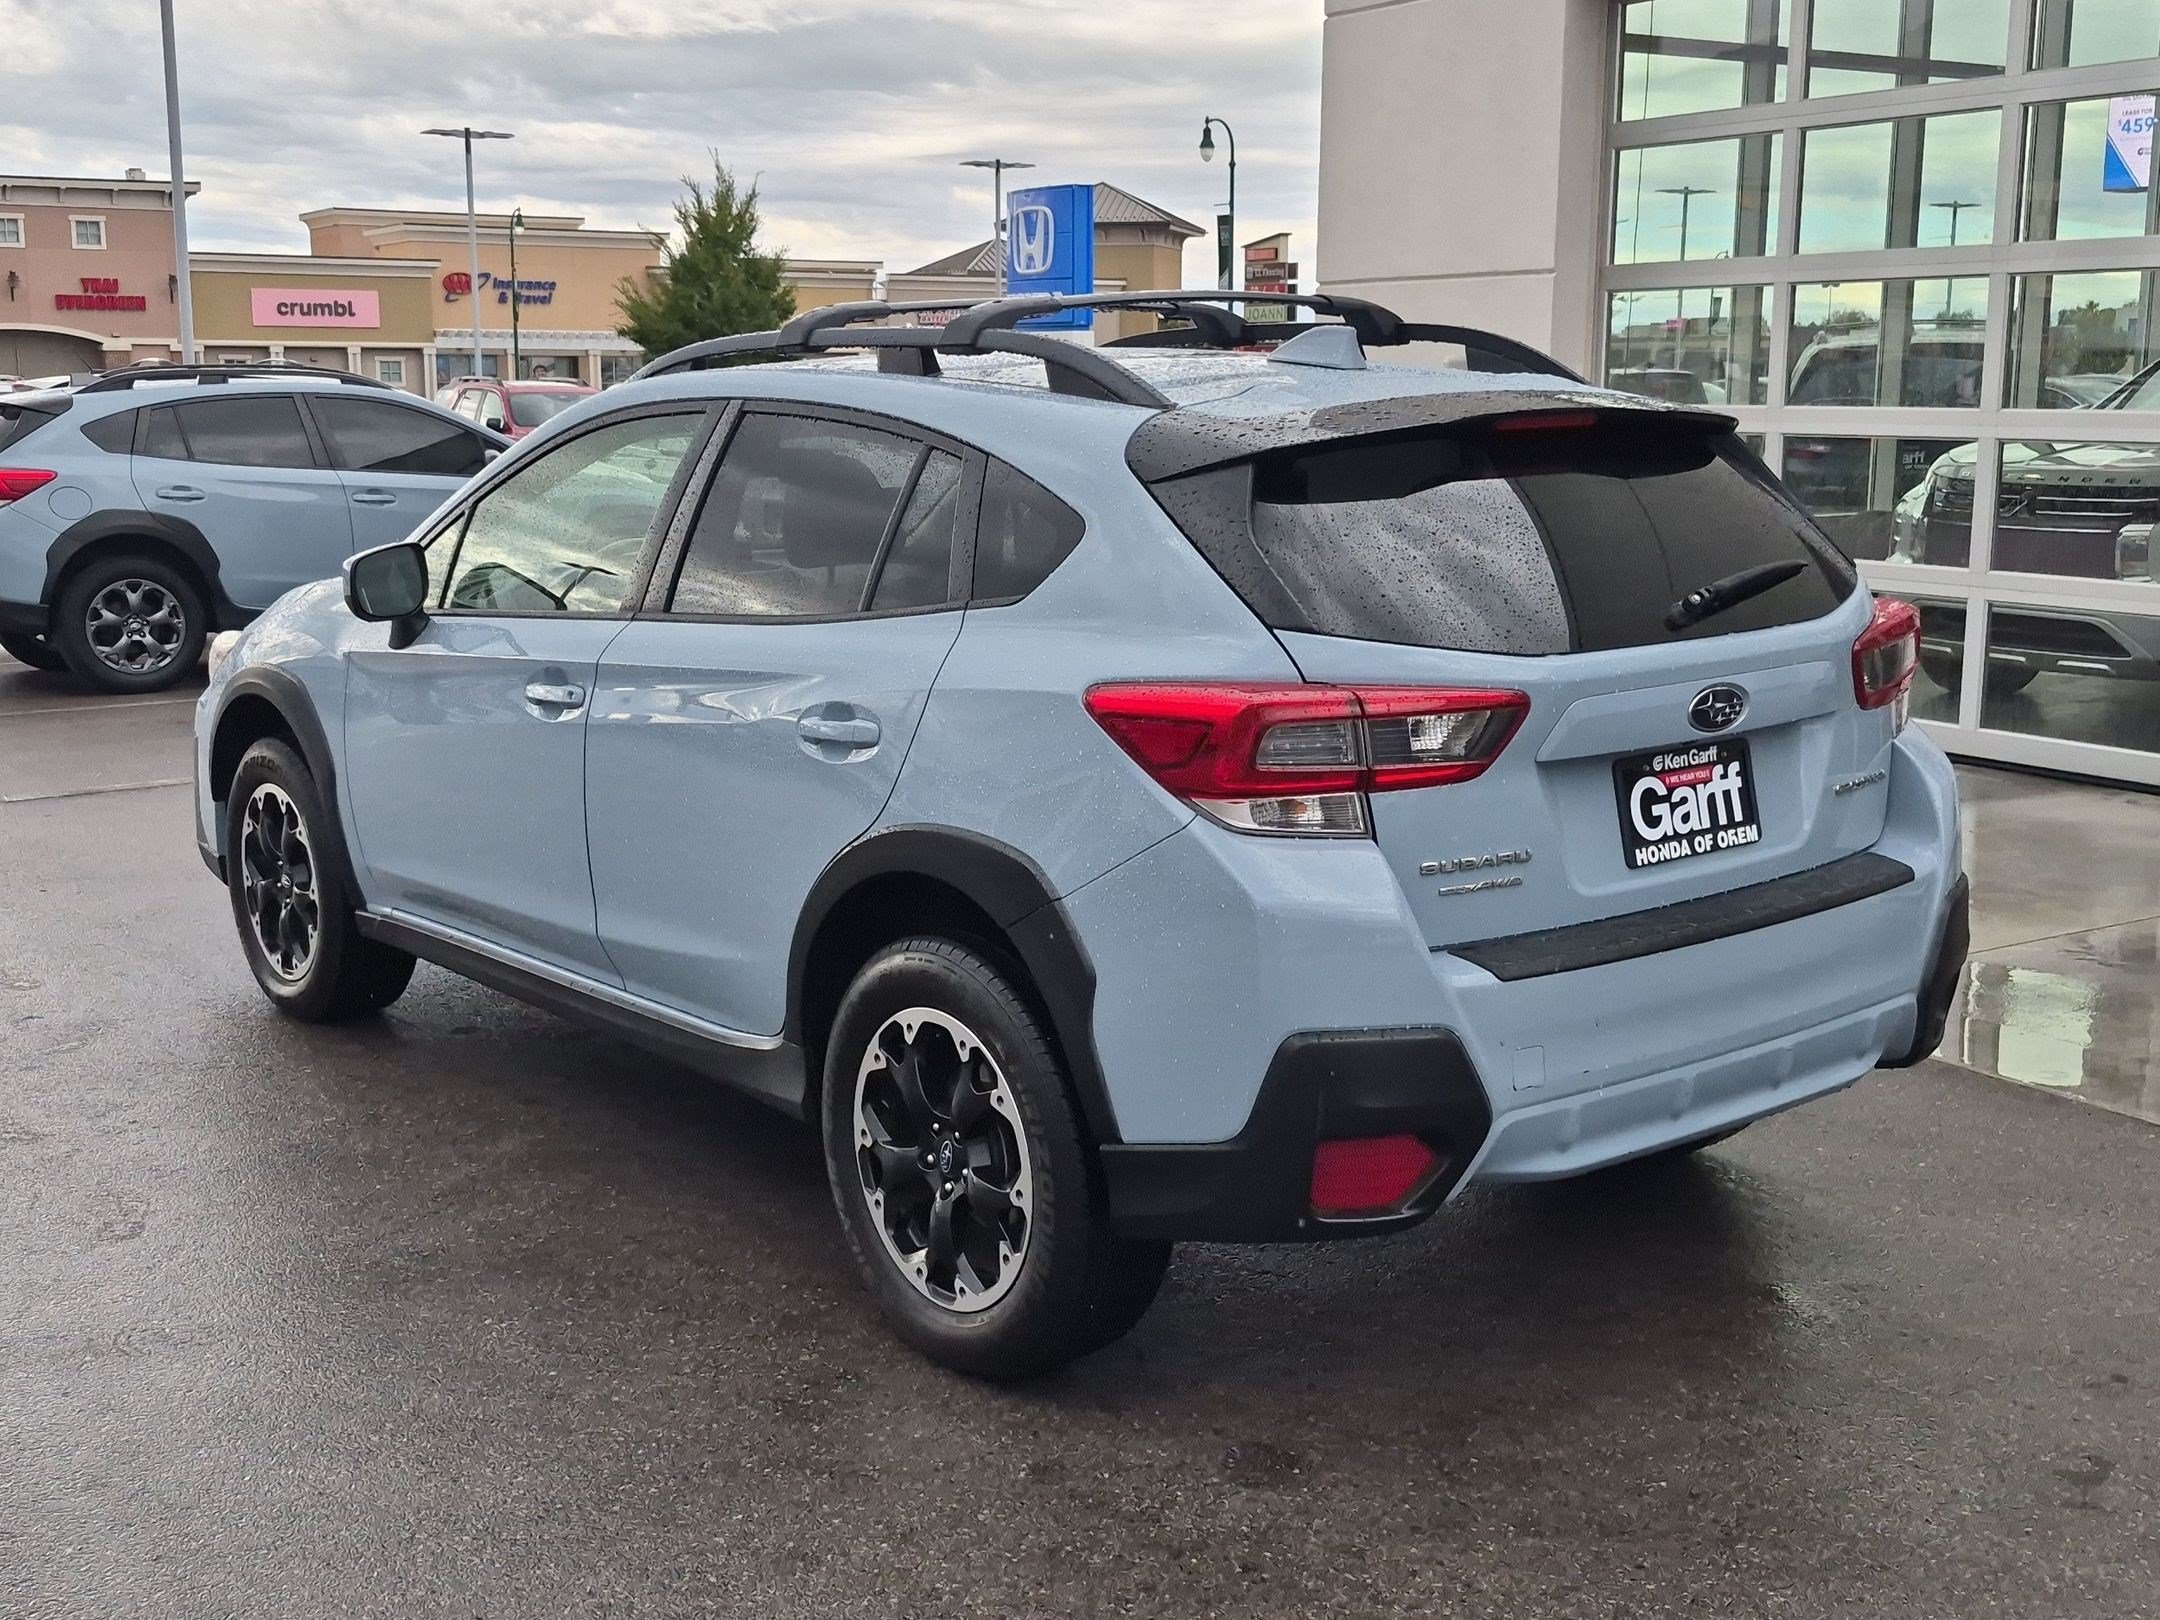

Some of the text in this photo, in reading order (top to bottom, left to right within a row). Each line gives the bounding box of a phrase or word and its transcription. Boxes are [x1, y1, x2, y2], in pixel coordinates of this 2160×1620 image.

[276, 300, 356, 317] crumbl
[1246, 307, 1283, 320] JOANN
[1664, 745, 1718, 771] Ken Garff
[1669, 770, 1706, 784] WE HEAR YOU
[1630, 761, 1743, 841] Garff
[1635, 824, 1759, 867] HONDA OF OREM
[1420, 848, 1533, 875] SUBARU
